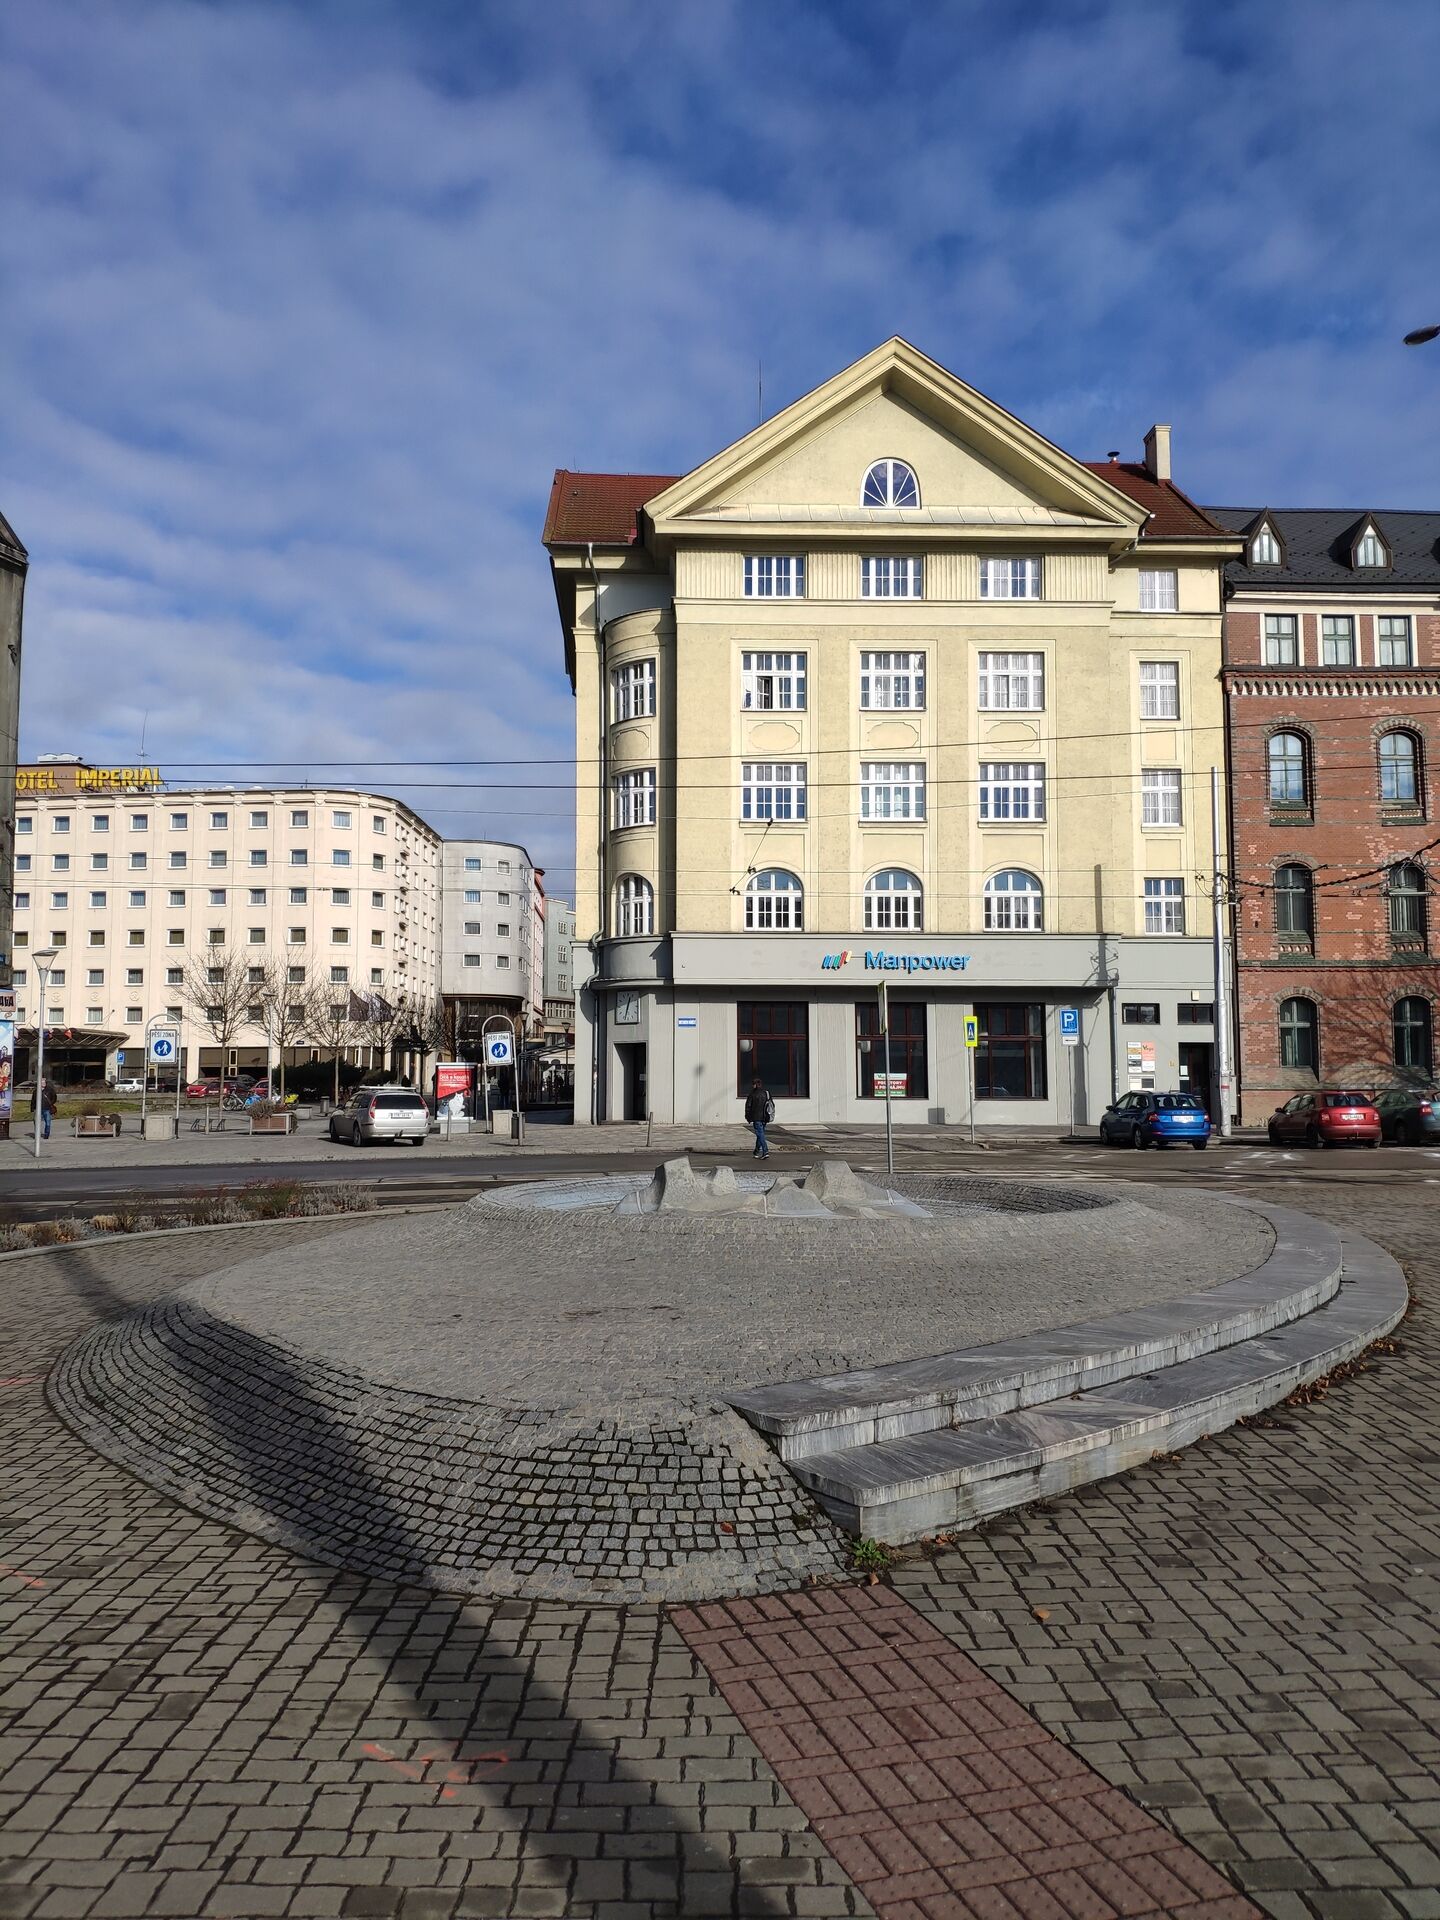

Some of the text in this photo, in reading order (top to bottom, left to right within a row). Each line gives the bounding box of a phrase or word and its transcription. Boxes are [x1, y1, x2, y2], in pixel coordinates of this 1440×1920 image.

[16, 767, 163, 790] OTEL IMPERIAL
[865, 951, 970, 974] Manpower
[1064, 1012, 1074, 1027] P
